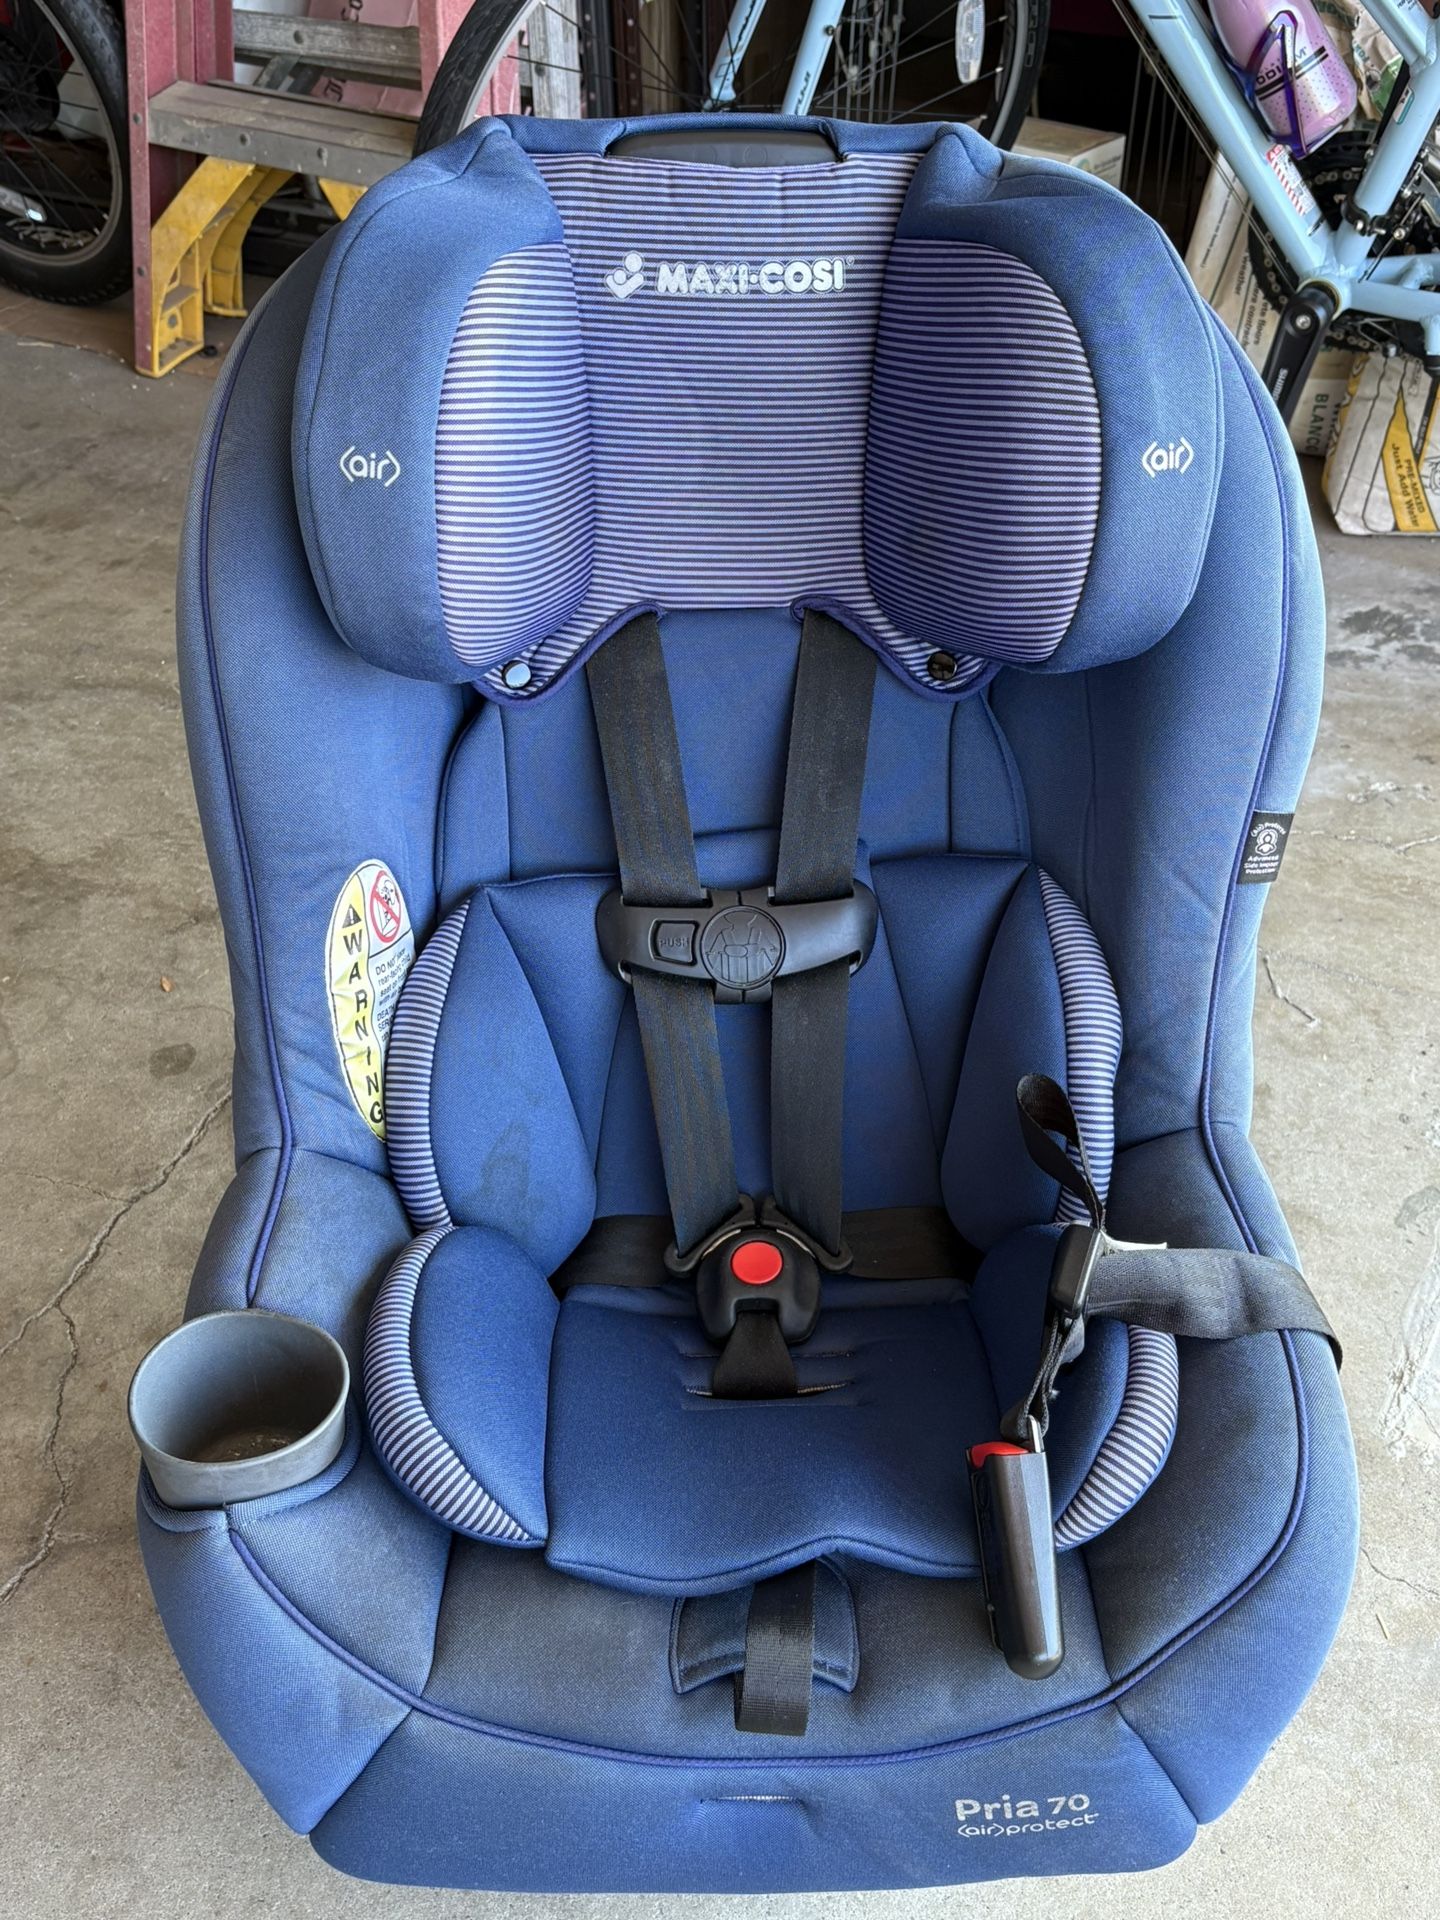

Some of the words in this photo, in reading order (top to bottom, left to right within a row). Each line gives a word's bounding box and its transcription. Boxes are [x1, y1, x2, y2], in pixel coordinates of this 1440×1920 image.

[658, 936, 690, 949] PUSH
[375, 963, 387, 976] DO
[343, 928, 385, 1124] WARNING
[954, 1794, 1040, 1822] Pria
[1047, 1793, 1091, 1815] 70
